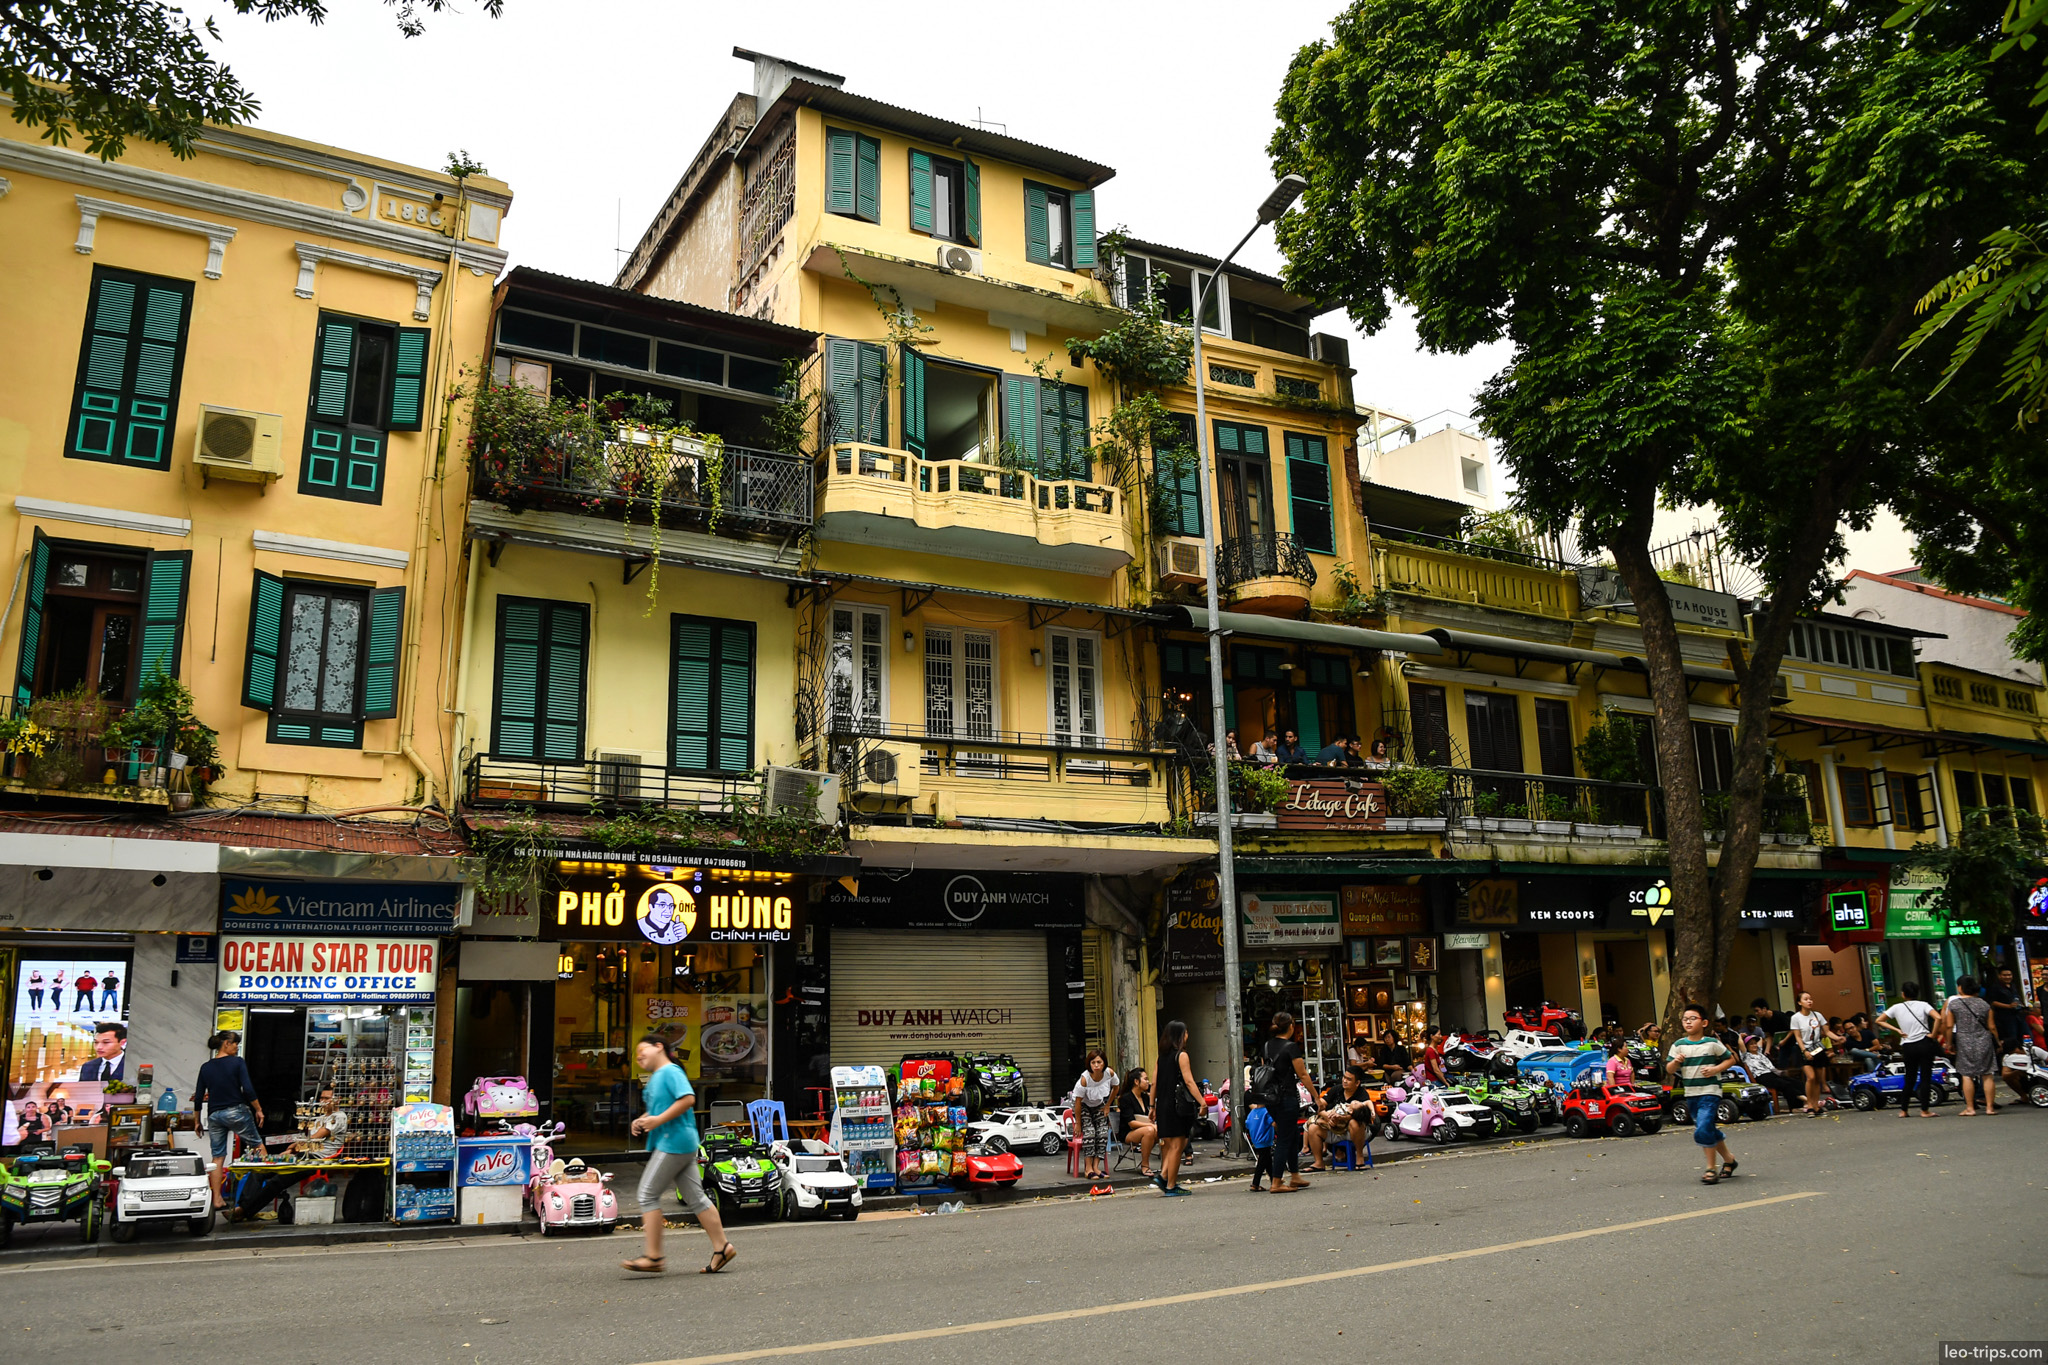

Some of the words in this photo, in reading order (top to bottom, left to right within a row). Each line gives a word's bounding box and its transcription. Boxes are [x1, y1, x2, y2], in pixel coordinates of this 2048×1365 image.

[1669, 599, 1690, 611] TEA
[1692, 602, 1727, 618] HOUSE
[565, 849, 581, 859] NHÀ
[582, 850, 602, 860] HÀNG
[640, 854, 651, 862] CN
[662, 854, 683, 864] HÀNG
[683, 856, 702, 865] KHAY
[558, 882, 626, 926] PHỞ
[842, 895, 847, 903] 7
[871, 896, 891, 904] KHAY
[953, 892, 978, 903] DUY
[981, 892, 1007, 904] ANH
[1009, 893, 1049, 905] WATCH
[285, 895, 374, 917] Vietnam
[378, 897, 455, 919] Airlines
[710, 890, 792, 929] HÙNG
[1835, 902, 1864, 921] aha
[1530, 910, 1551, 920] KEM
[1555, 910, 1595, 920] SCOOPS
[1751, 910, 1768, 919] TEA
[1772, 910, 1795, 919] JUICE
[224, 921, 271, 929] DOMESTIC
[282, 923, 351, 931] INTERNATIONAL
[711, 929, 755, 941] CHÍNH
[758, 930, 790, 942] HIỆU
[224, 941, 304, 973] OCEAN
[311, 943, 368, 973] STAR
[376, 943, 434, 974] TOUR
[239, 975, 337, 989] BOOKING
[344, 976, 416, 989] OFFICE
[248, 993, 268, 1001] Hang
[858, 1009, 897, 1026] DUY
[902, 1009, 943, 1026] ANH
[950, 1008, 1012, 1025] WATCH
[889, 1031, 983, 1040] www.donghoduyanh.com
